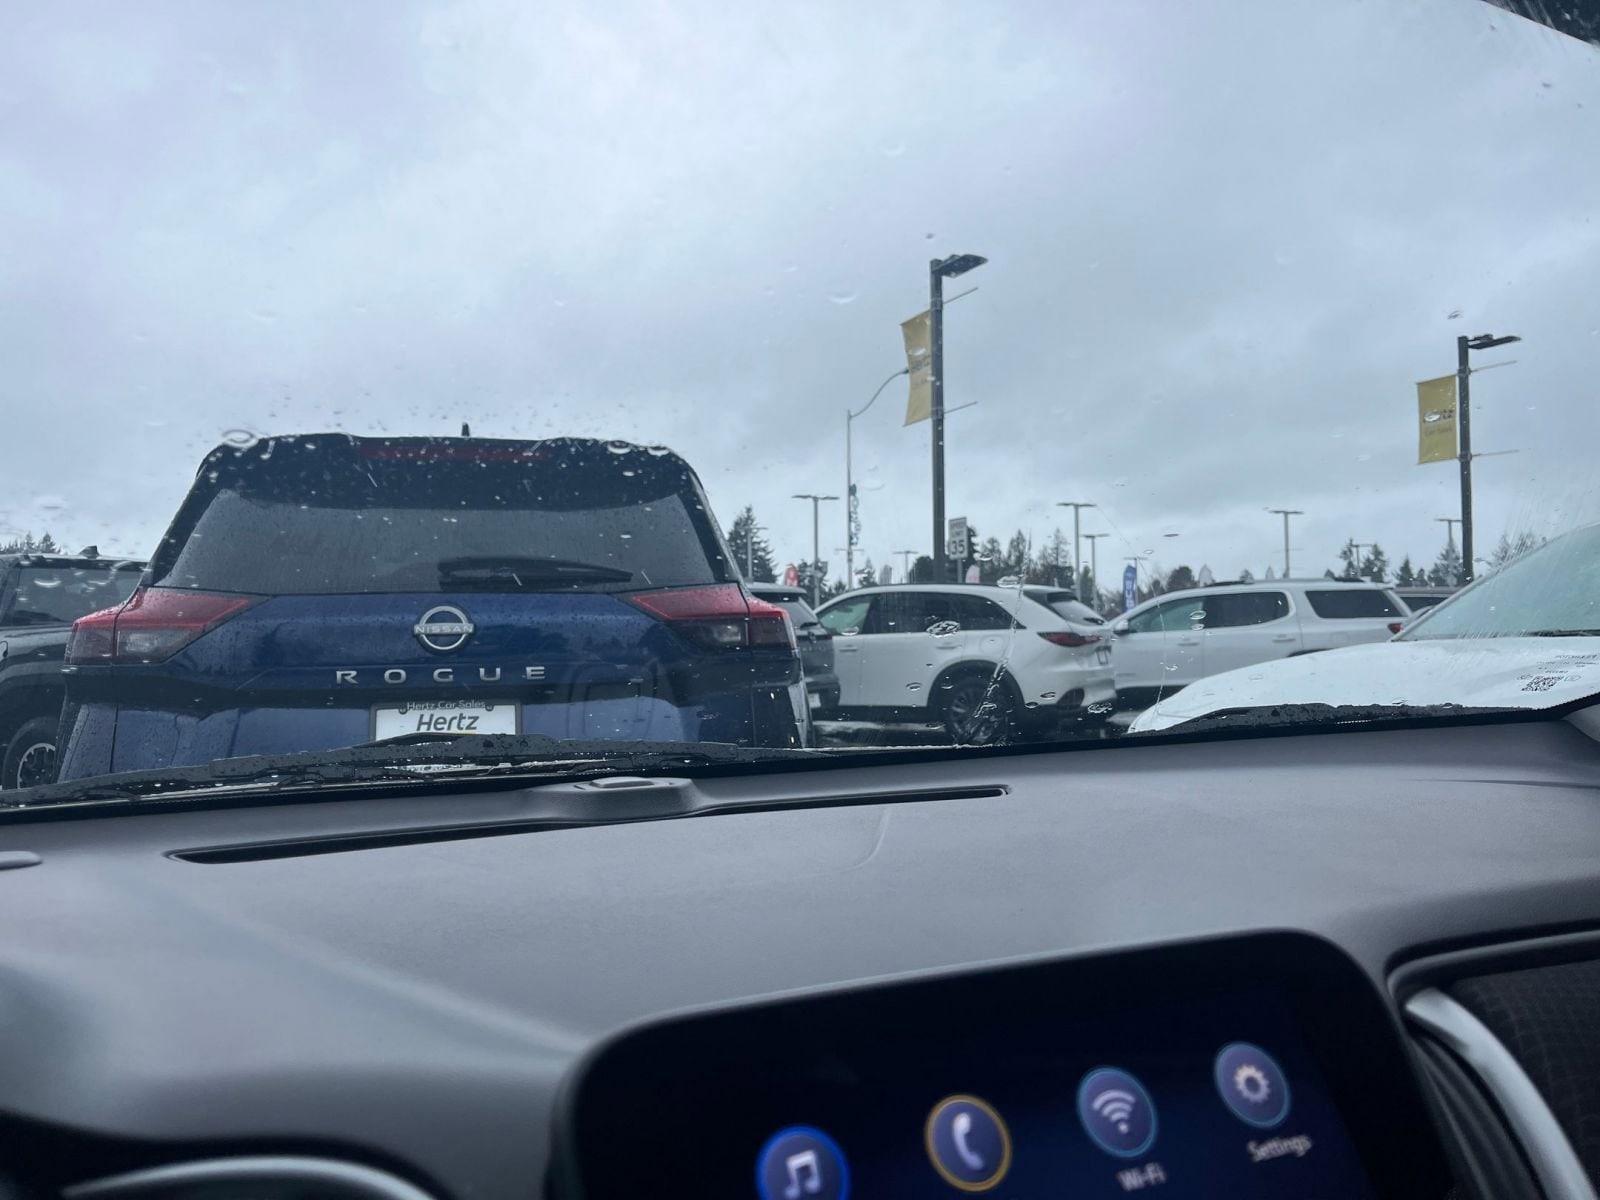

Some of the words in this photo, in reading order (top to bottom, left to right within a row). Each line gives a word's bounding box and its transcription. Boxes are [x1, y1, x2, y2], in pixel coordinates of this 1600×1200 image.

[951, 539, 965, 555] 35
[414, 624, 474, 634] NISSAN
[336, 666, 546, 684] ROGUE
[406, 702, 436, 711] Hertz
[438, 701, 457, 710] Car
[458, 700, 486, 709] Sales
[416, 713, 480, 732] Hertz
[1247, 1134, 1312, 1162] Settings
[1117, 1162, 1166, 1191] Wi-Fi
